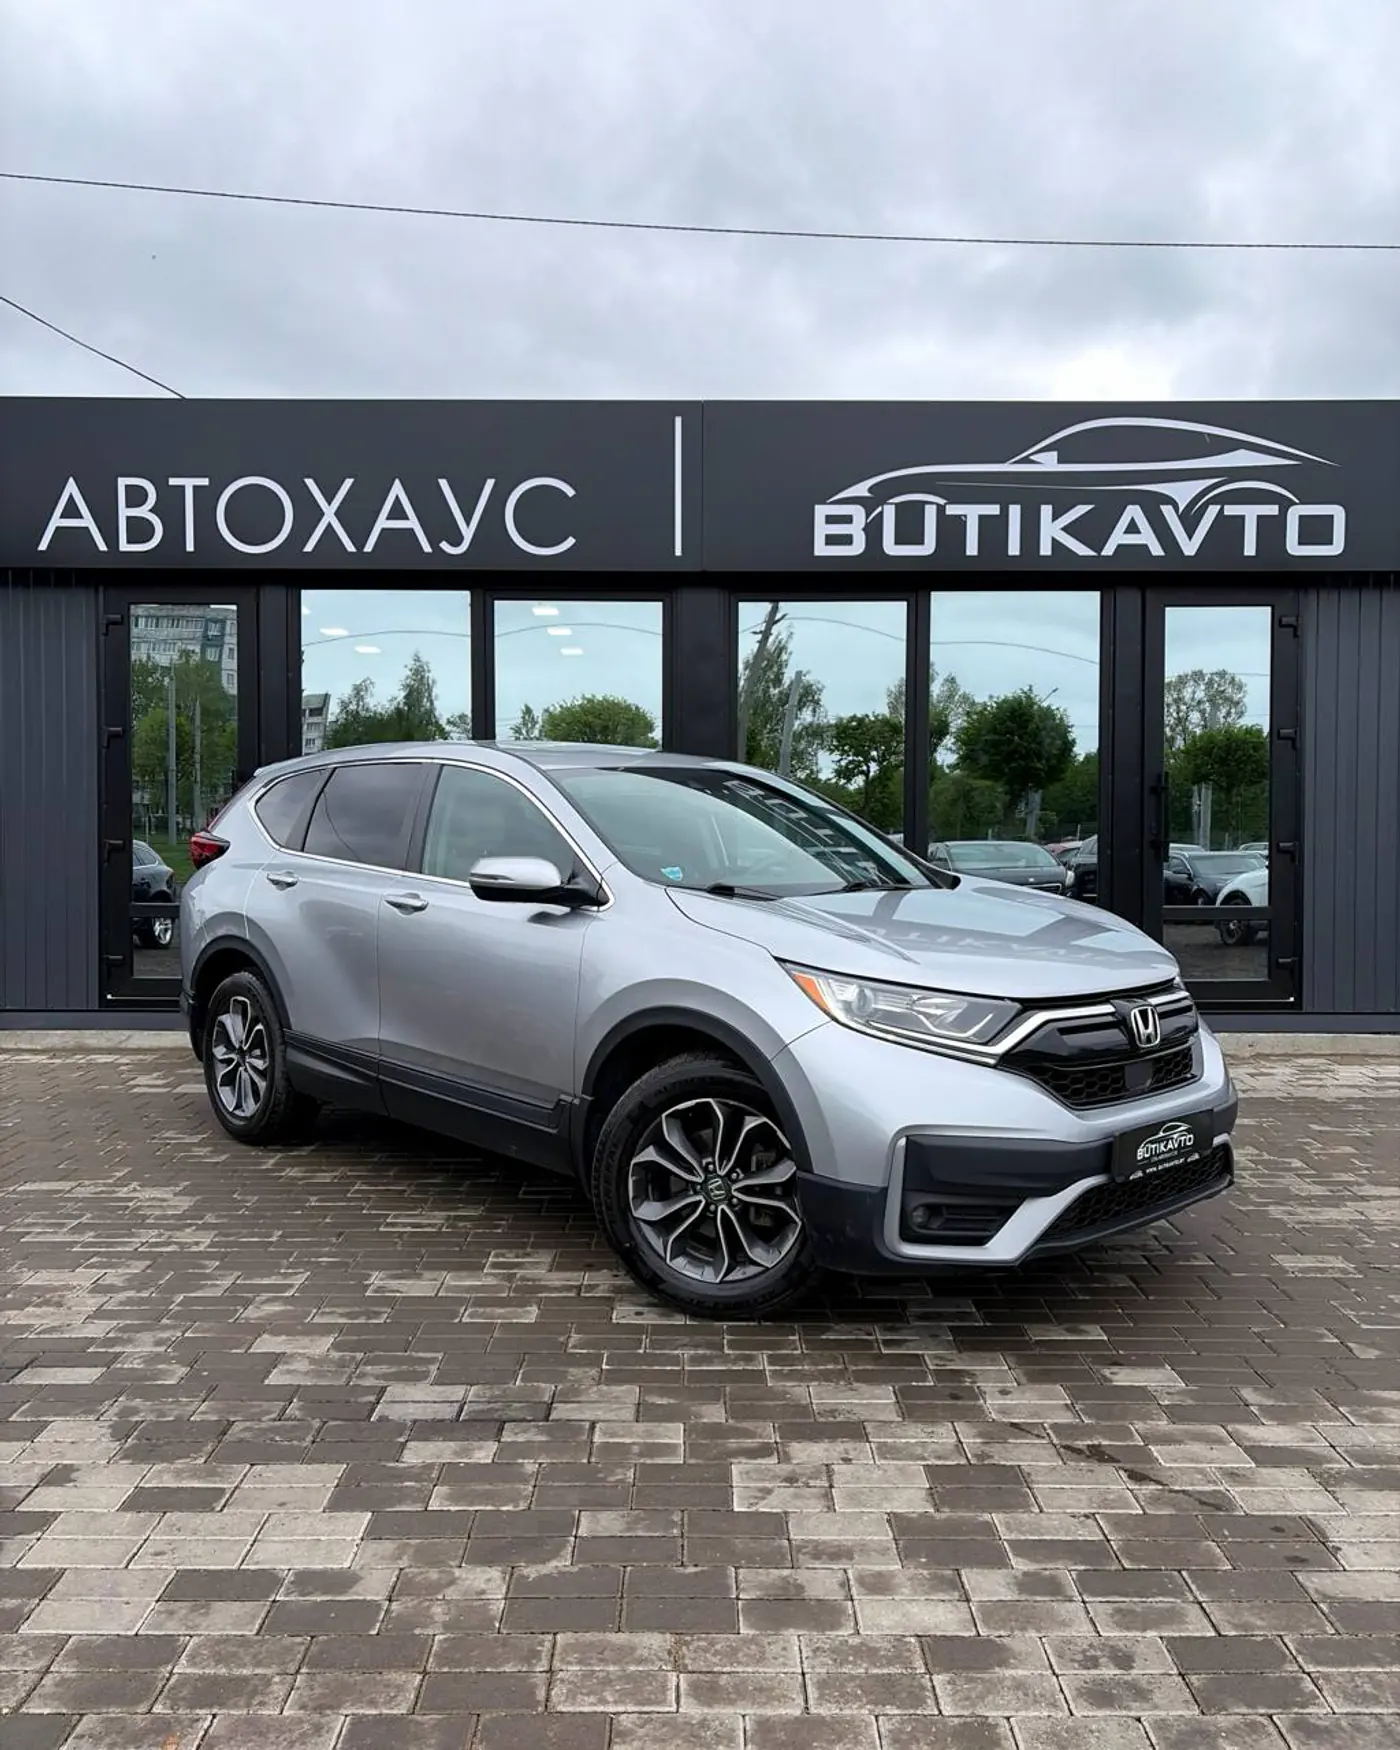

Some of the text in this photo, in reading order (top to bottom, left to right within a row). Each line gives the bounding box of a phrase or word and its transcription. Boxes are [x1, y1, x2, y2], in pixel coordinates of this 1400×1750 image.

[38, 476, 576, 555] АВТОХАУС
[814, 503, 1345, 556] BUTIKAVTO
[1136, 1133, 1194, 1161] BUTIKAVTO
